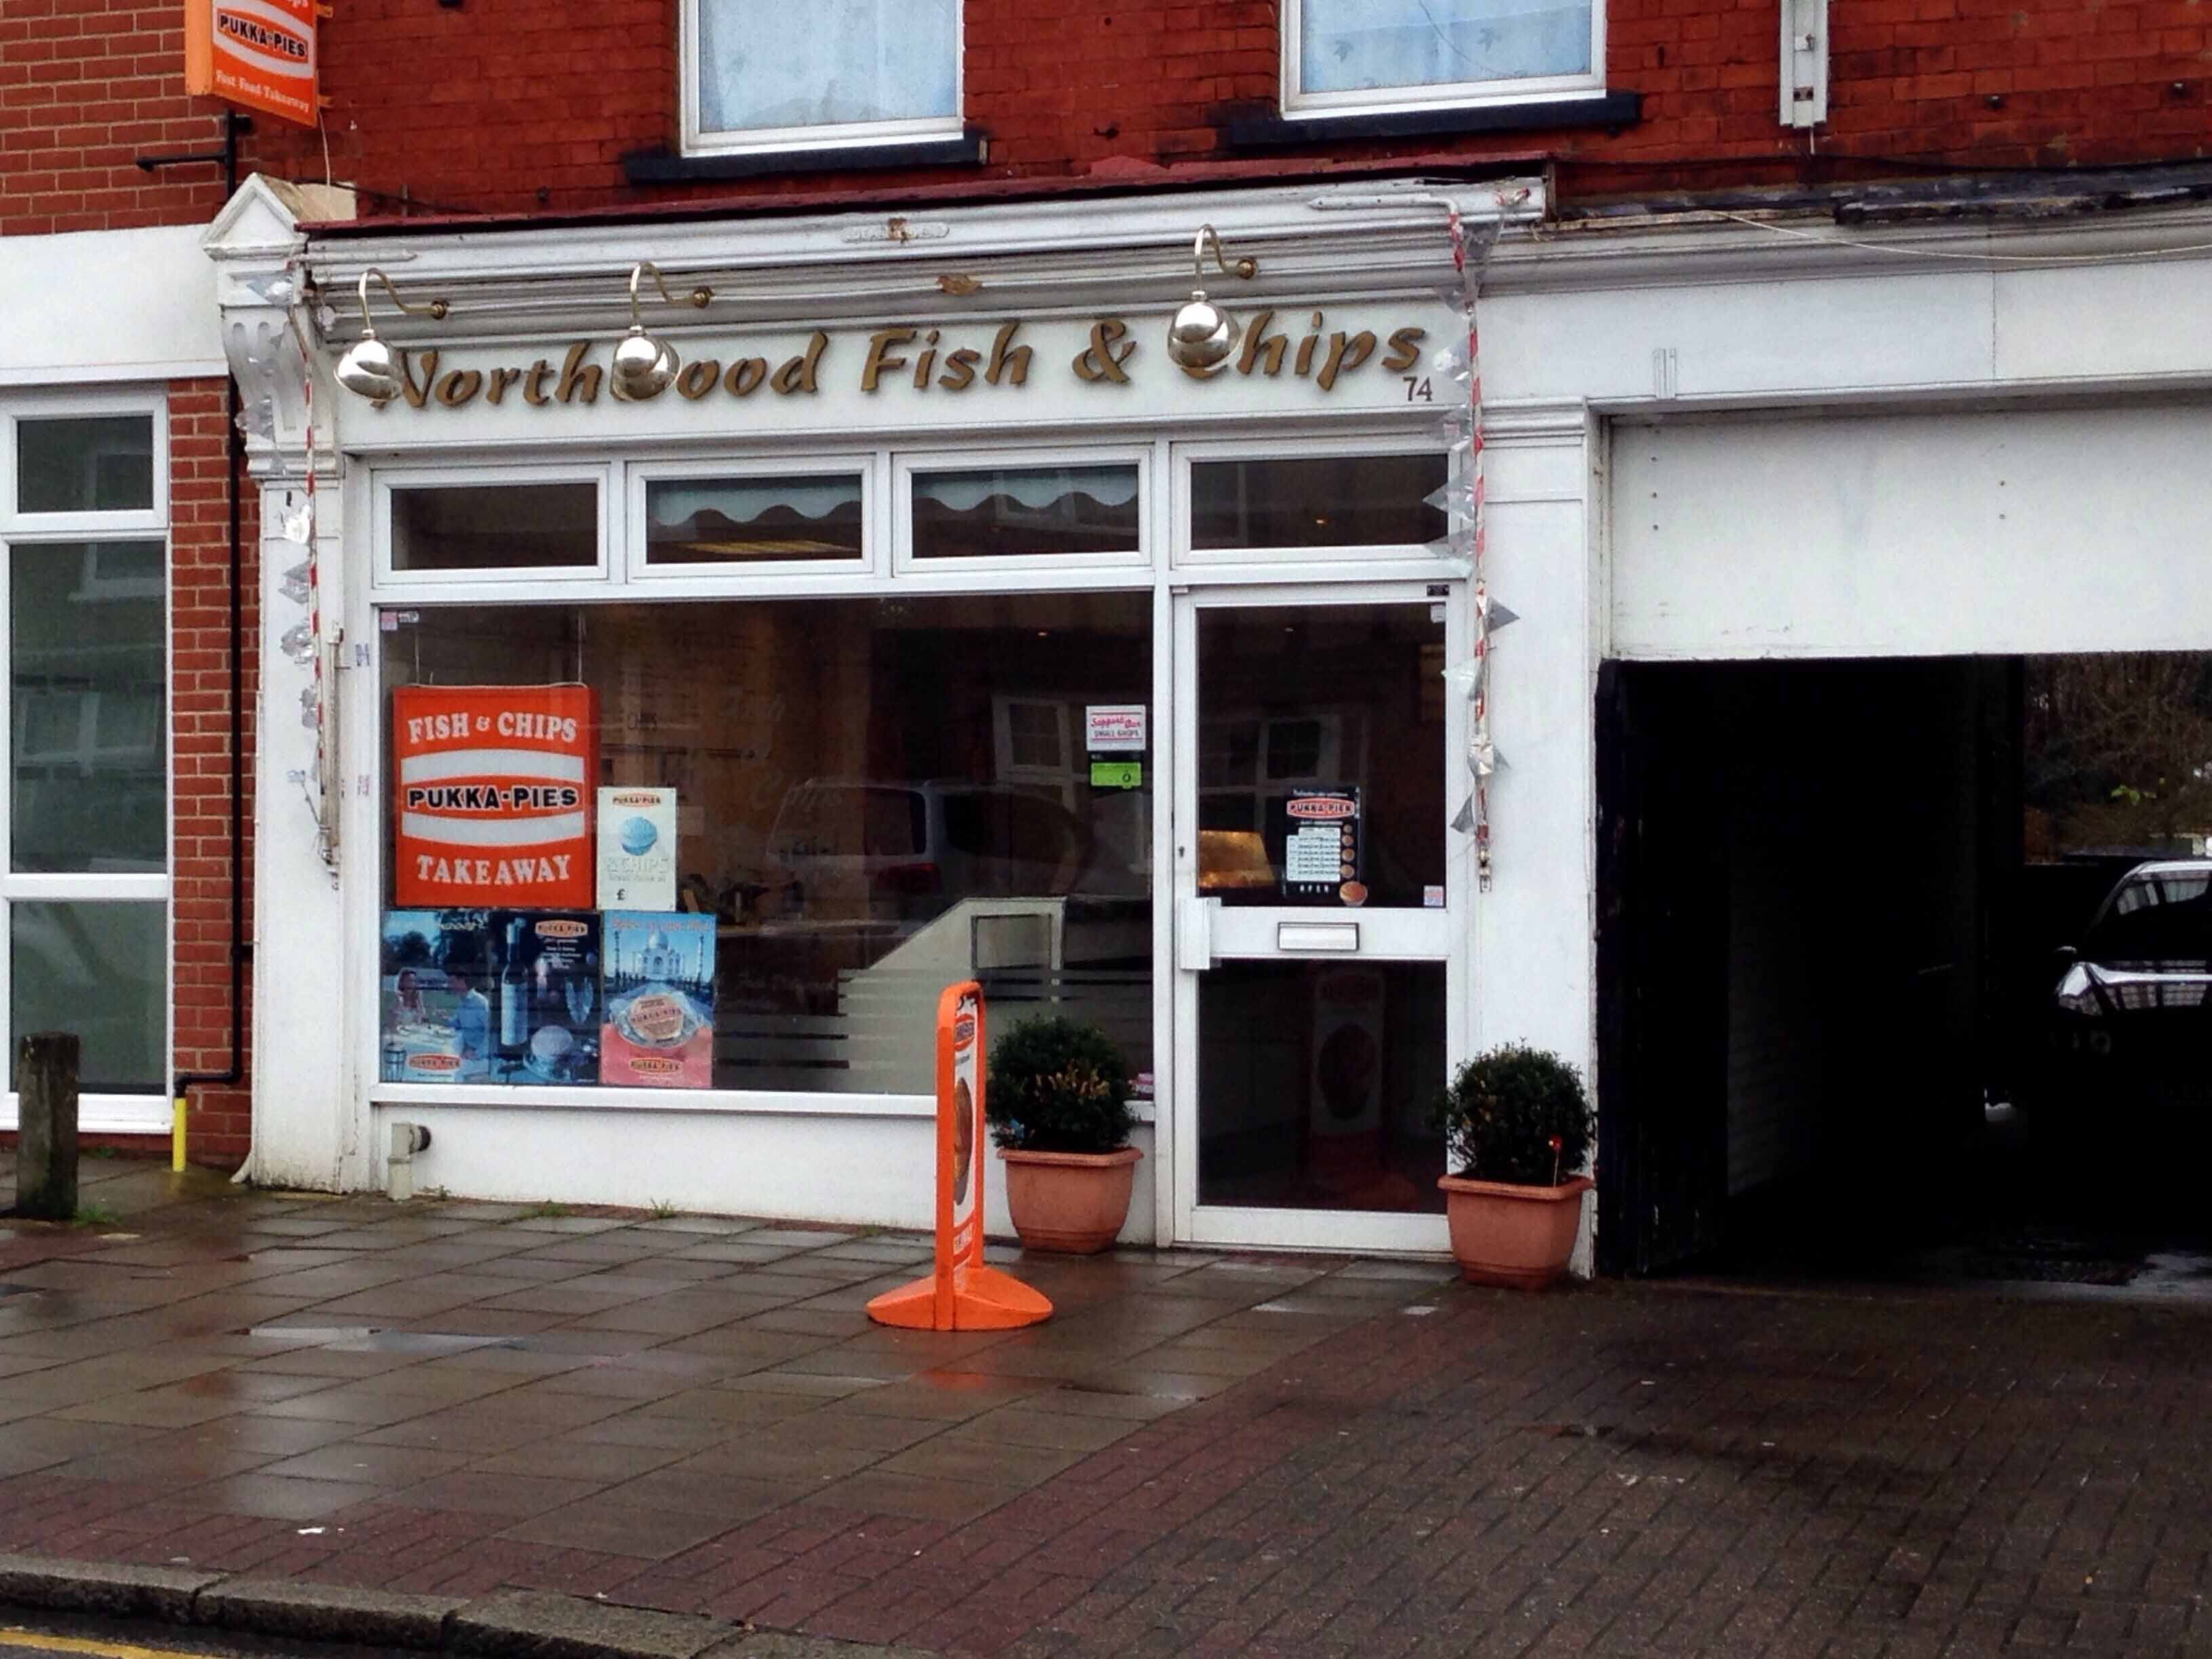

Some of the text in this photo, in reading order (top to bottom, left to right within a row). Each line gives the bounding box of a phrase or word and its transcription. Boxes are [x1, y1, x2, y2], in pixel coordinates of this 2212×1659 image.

[369, 310, 1427, 409] Northood Fish & hips
[1403, 376, 1433, 402] 74
[408, 711, 577, 744] FISH & CHIPS
[417, 854, 571, 885] TAKEAWAY
